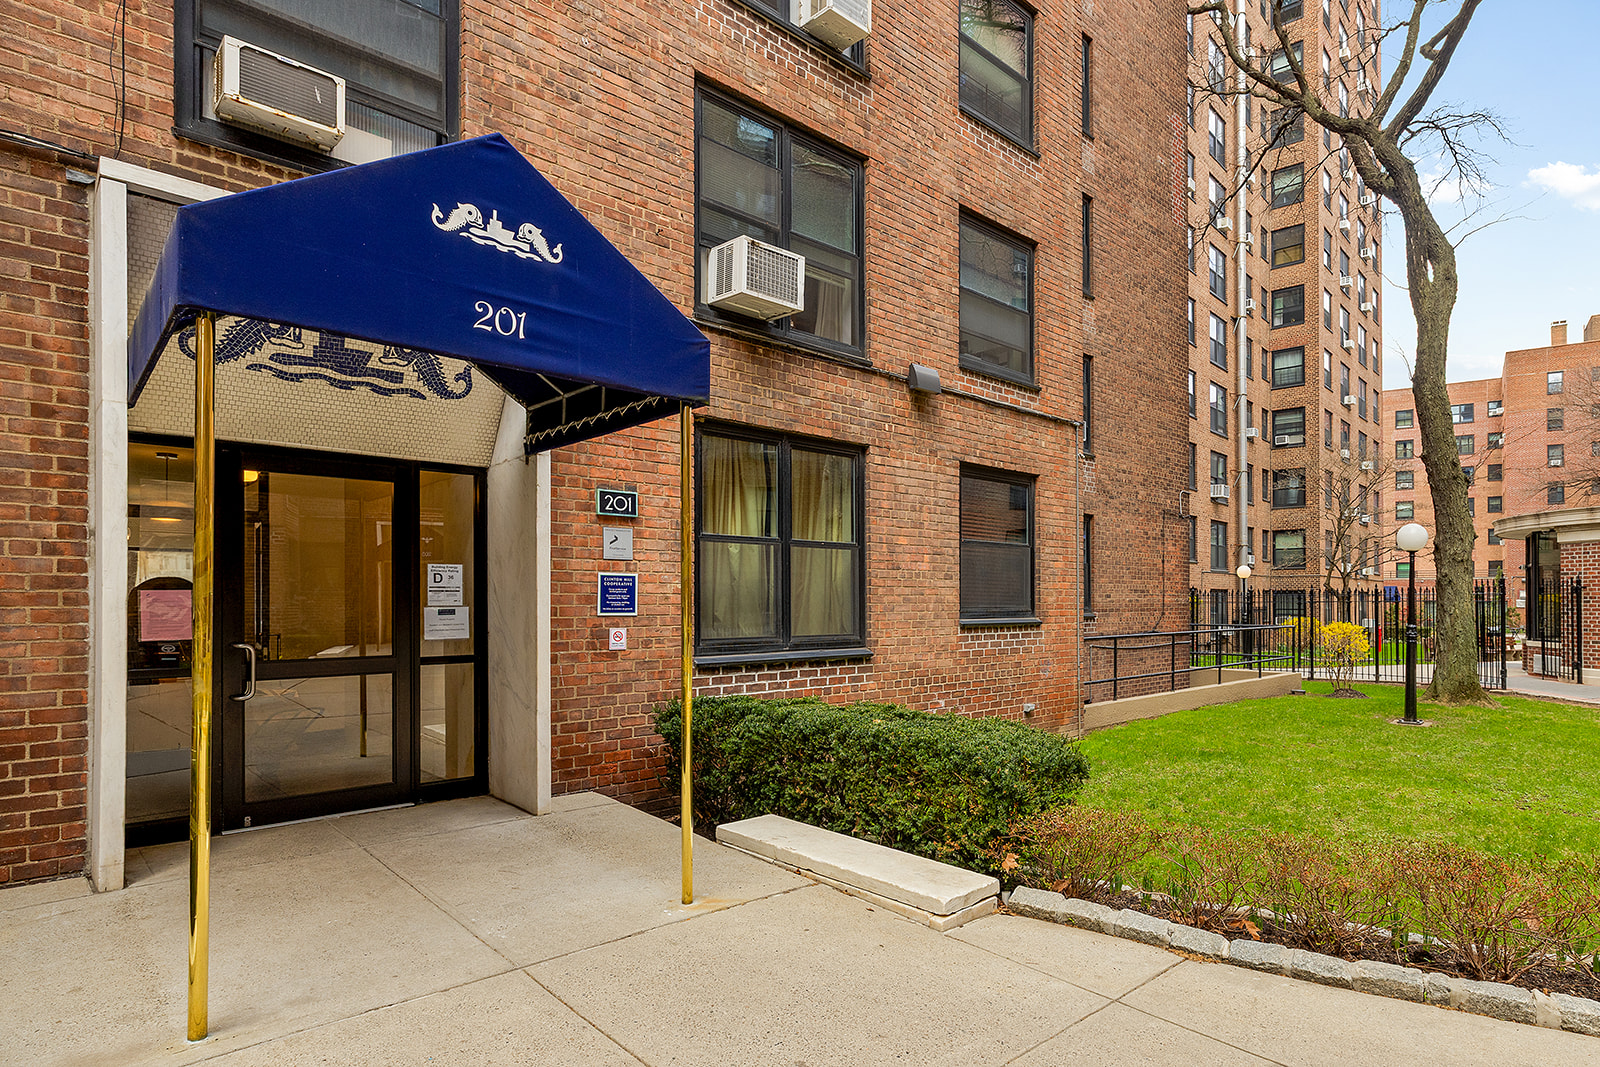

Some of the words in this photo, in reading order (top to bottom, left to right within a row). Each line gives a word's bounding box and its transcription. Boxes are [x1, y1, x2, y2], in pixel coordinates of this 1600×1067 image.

[473, 300, 527, 339] 201
[604, 495, 632, 512] 201
[433, 573, 443, 583] D
